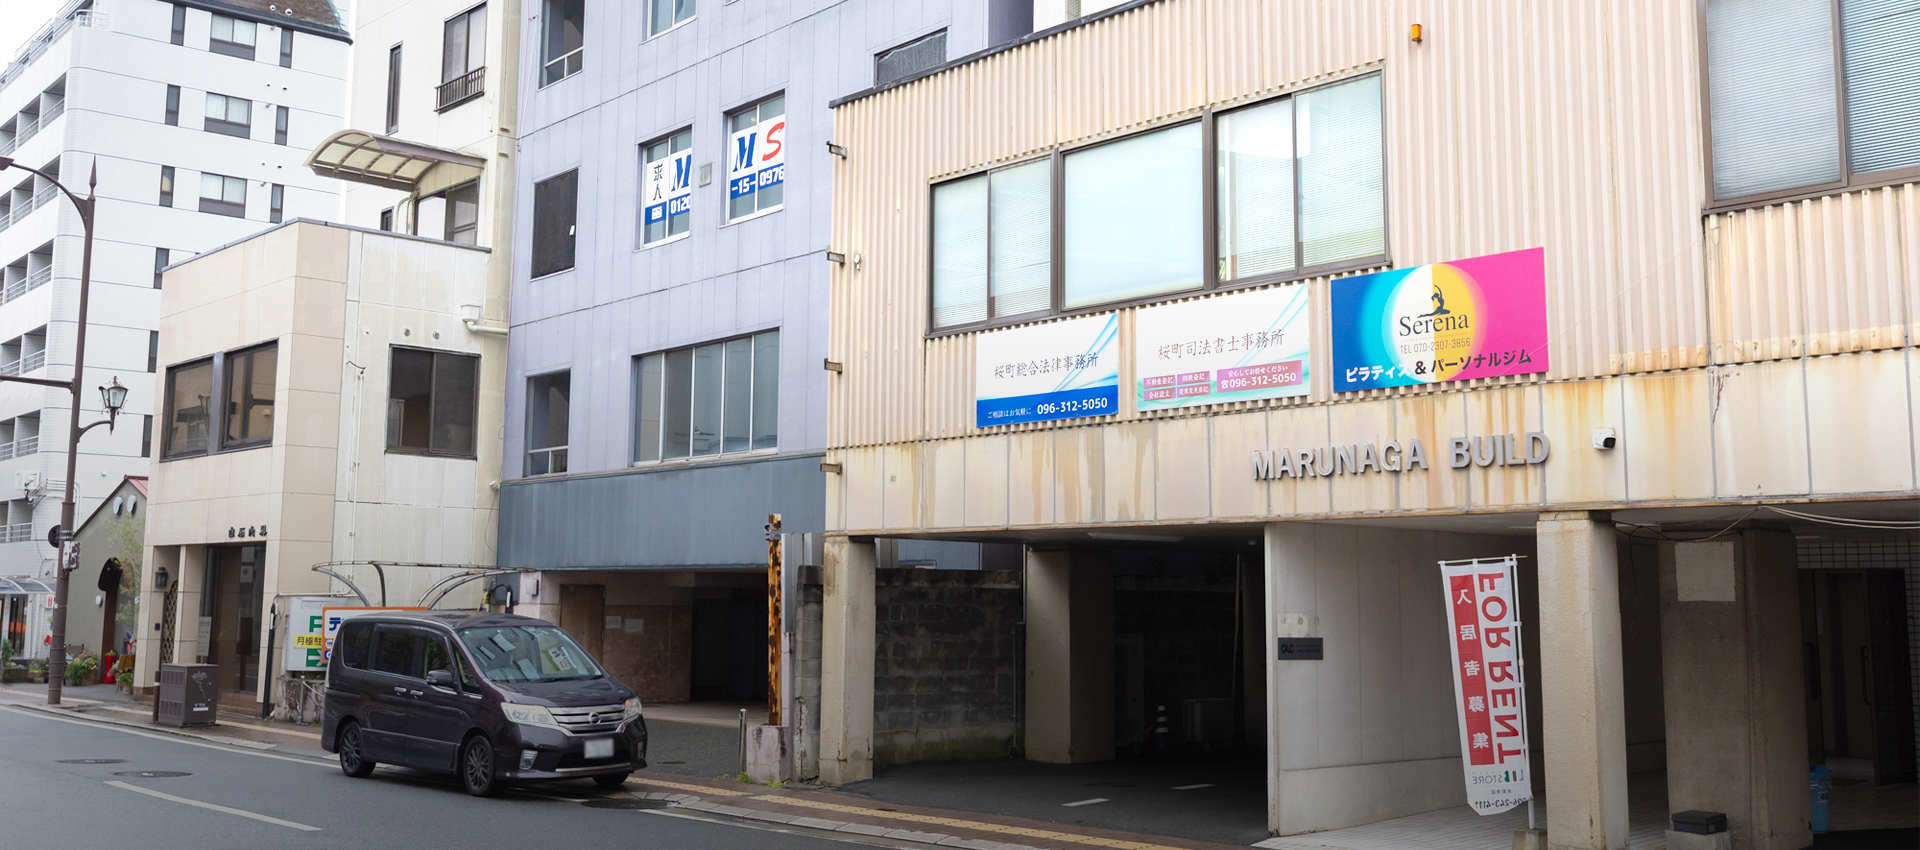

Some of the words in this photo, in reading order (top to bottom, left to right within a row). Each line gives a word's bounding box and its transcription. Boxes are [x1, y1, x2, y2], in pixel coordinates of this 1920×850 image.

[653, 163, 663, 201] 求人
[1399, 314, 1469, 336] Serena
[1158, 329, 1285, 361] 桜町司法書士事務所
[1400, 345, 1412, 355] TEL
[1414, 337, 1471, 353] 070-2307-3856
[994, 352, 1098, 379] 桜町総合法律事務所
[1346, 363, 1411, 383] ピラティス
[1414, 361, 1426, 375] &
[1431, 349, 1532, 373] パーソナルジム
[1229, 372, 1297, 388] 096-312-5050
[1037, 397, 1108, 414] 096-312-5050
[1252, 439, 1429, 480] MARUNAGA
[1450, 431, 1551, 469] BUILD
